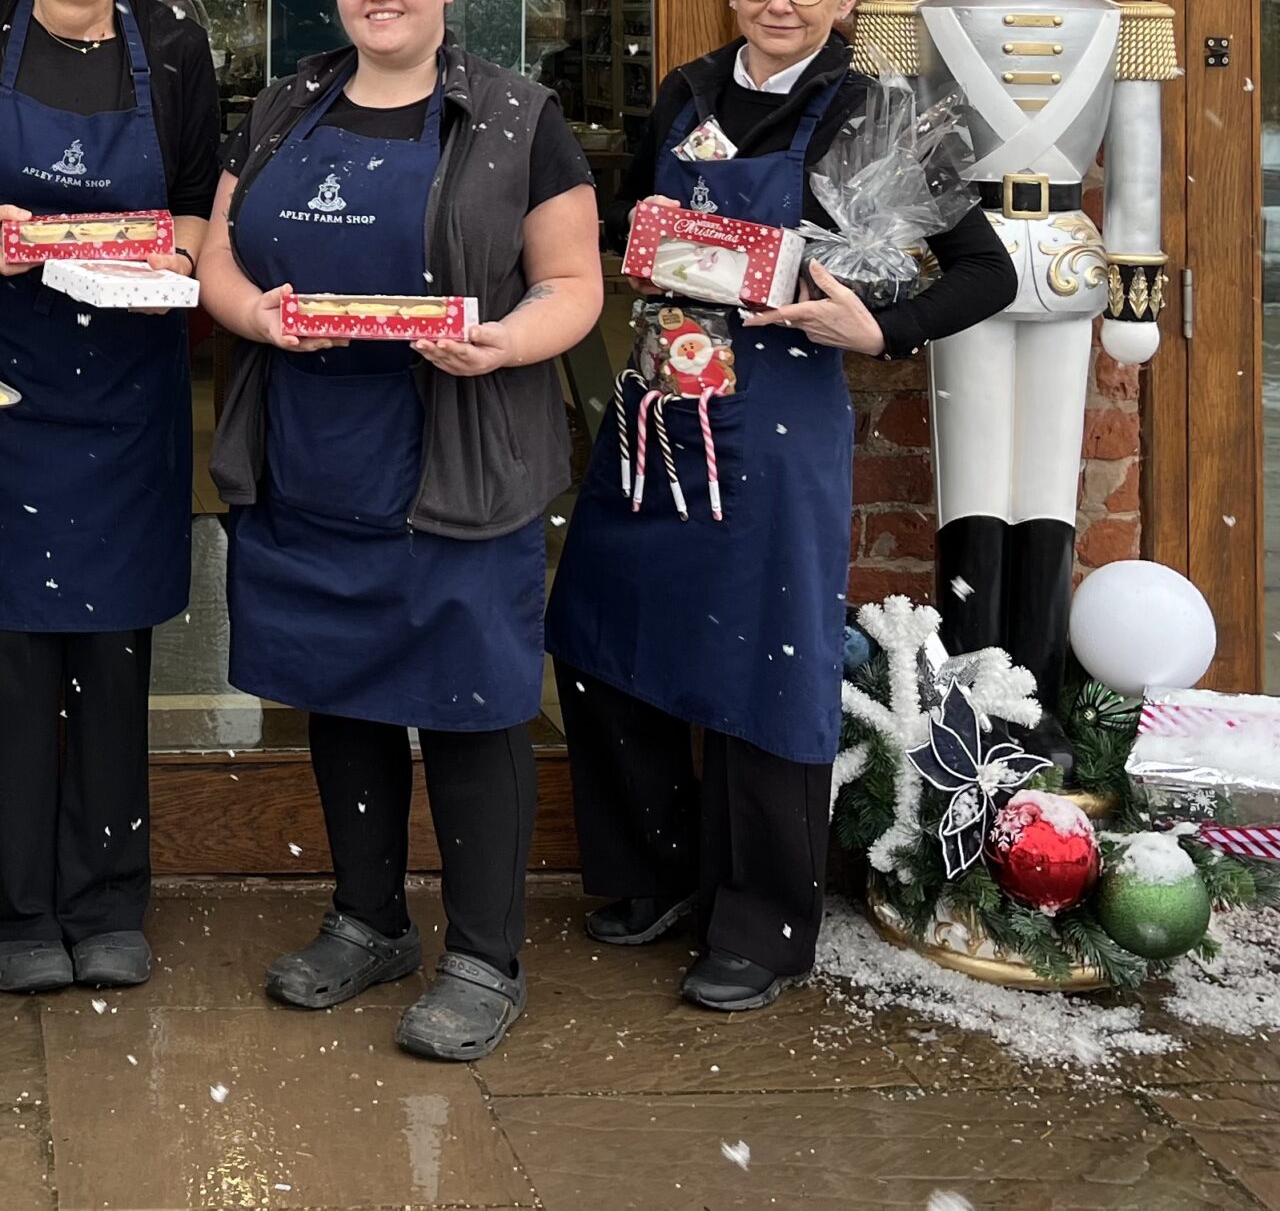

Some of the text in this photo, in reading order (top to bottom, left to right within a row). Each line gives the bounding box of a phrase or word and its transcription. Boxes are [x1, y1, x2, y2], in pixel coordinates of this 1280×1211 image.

[22, 166, 112, 188] APLEY FARM SHOP
[279, 209, 376, 224] APLEY FARM SHOP
[673, 218, 740, 243] Christmas
